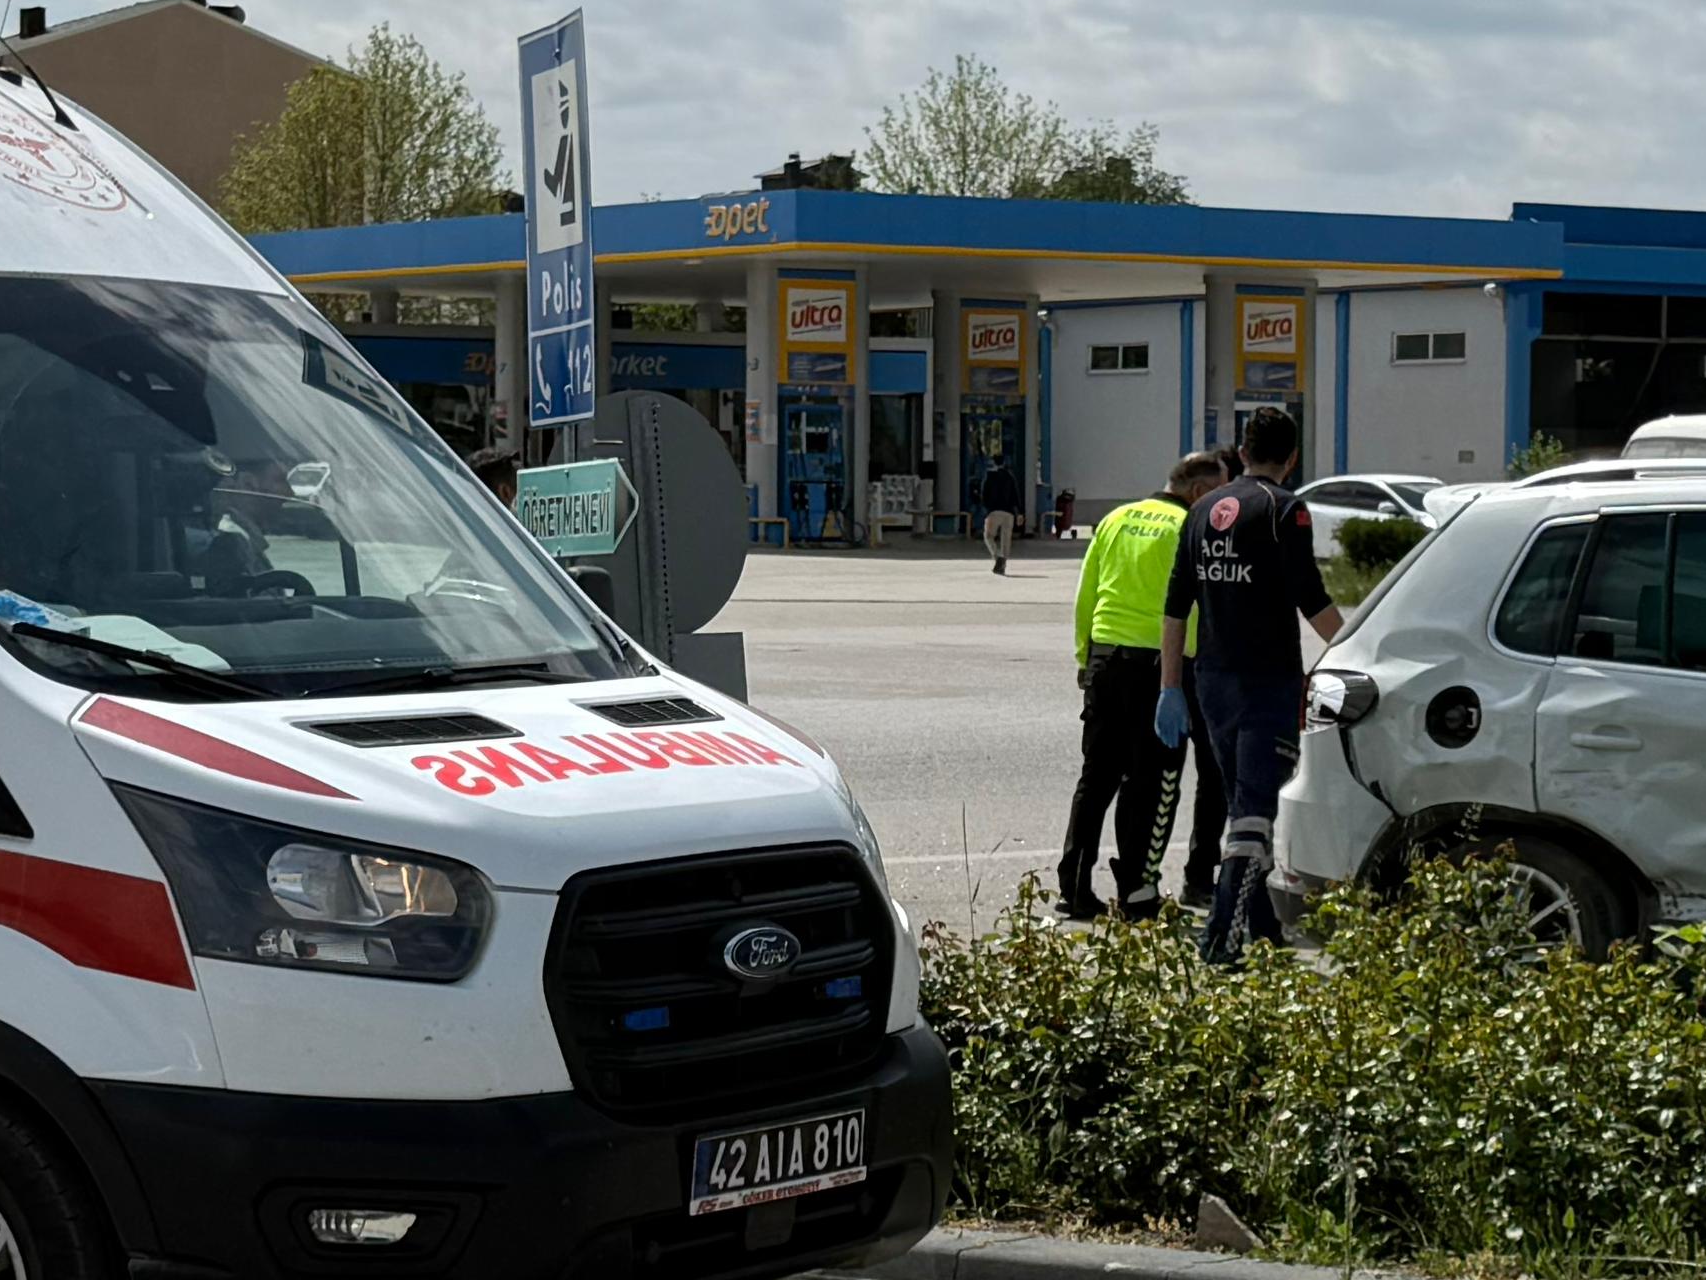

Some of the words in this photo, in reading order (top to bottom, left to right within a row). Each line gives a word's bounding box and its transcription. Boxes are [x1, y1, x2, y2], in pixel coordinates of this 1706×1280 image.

[541, 264, 582, 317] Polis
[790, 304, 842, 329] ultra
[1246, 317, 1293, 341] ultra
[972, 327, 1016, 349] ultra
[748, 935, 790, 966] Ford
[709, 1139, 747, 1190] 42
[753, 1127, 804, 1184] AIA
[813, 1116, 860, 1170] 810
